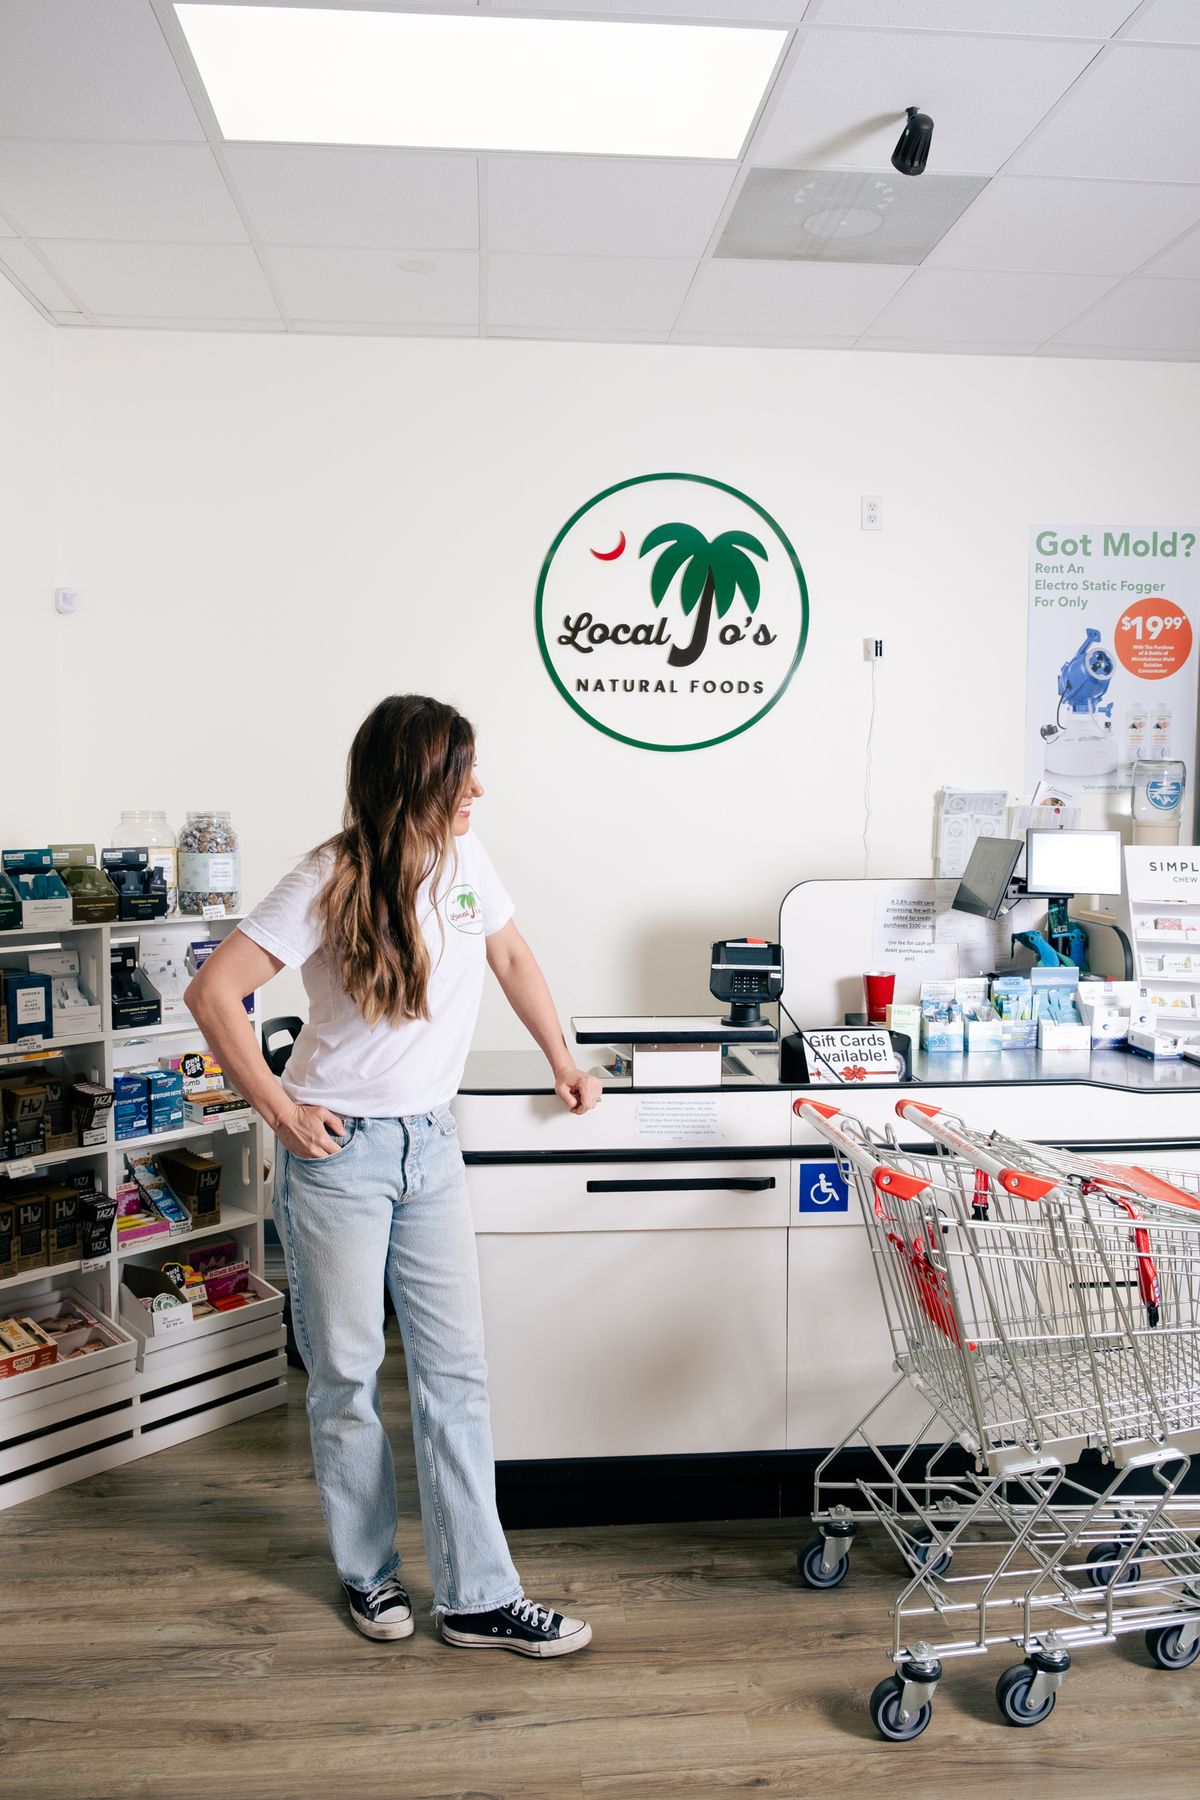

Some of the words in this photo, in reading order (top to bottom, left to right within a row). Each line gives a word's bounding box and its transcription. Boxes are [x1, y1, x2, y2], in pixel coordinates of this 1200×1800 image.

[1036, 530, 1092, 556] Got
[1103, 532, 1196, 558] Mold?
[1034, 563, 1064, 574] Rent
[1067, 563, 1084, 574] An
[1034, 580, 1078, 590] Electro
[1082, 580, 1117, 591] Static
[1121, 580, 1165, 594] Fogger
[1034, 596, 1054, 607] For
[1058, 596, 1088, 610] Only
[557, 612, 672, 654] Local
[667, 566, 778, 668] Jo's
[576, 678, 678, 693] NATURAL
[690, 680, 764, 694] FOODS
[1150, 862, 1199, 872] SIMPL
[810, 1034, 836, 1047] Gift
[840, 1034, 885, 1047] Cards
[814, 1049, 888, 1062] Available!
[94, 1094, 112, 1106] TAZA
[97, 1208, 115, 1220] TAZA
[92, 1240, 106, 1251] TAZA
